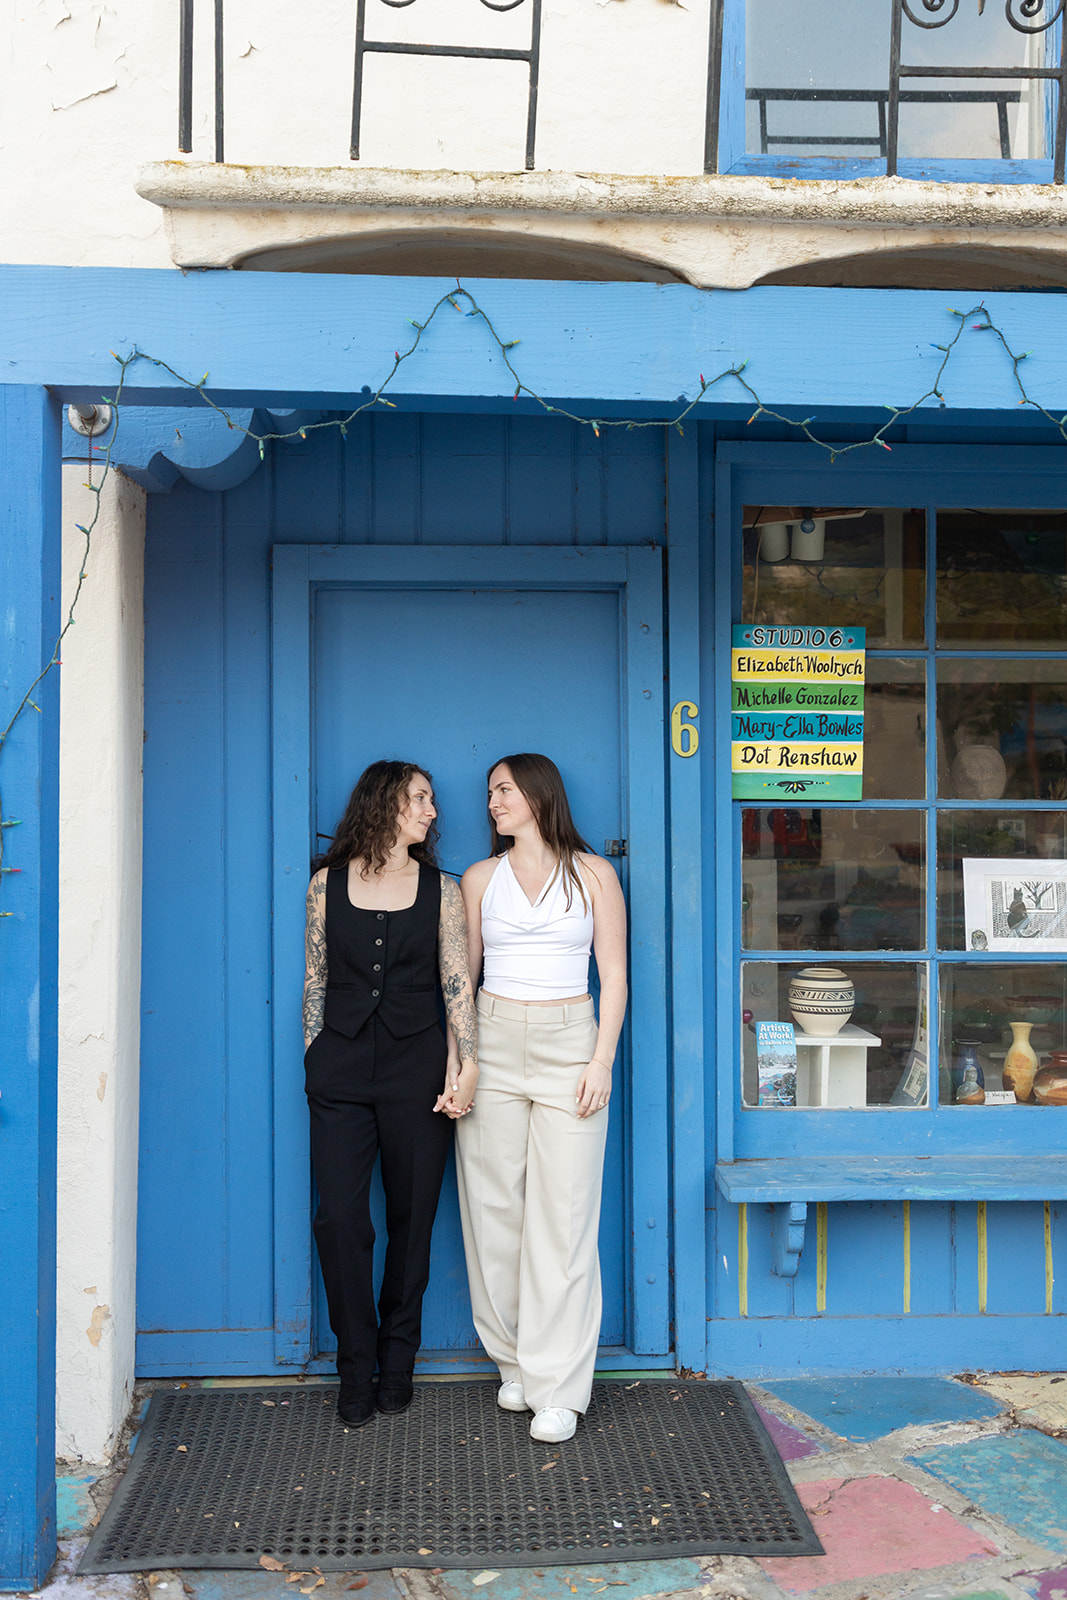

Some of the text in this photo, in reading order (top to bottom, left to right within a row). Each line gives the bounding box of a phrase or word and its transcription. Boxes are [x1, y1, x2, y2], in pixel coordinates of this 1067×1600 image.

[752, 627, 843, 648] STUDIO 6
[737, 655, 864, 677] Elizabeth Woolrych
[736, 687, 859, 708] Michelle Gonzalez
[671, 700, 699, 758] 6
[816, 714, 864, 738] Bowles
[741, 746, 858, 768] Dot Renshaw
[758, 1031, 793, 1040] At Work!
[760, 1023, 790, 1032] Artists
